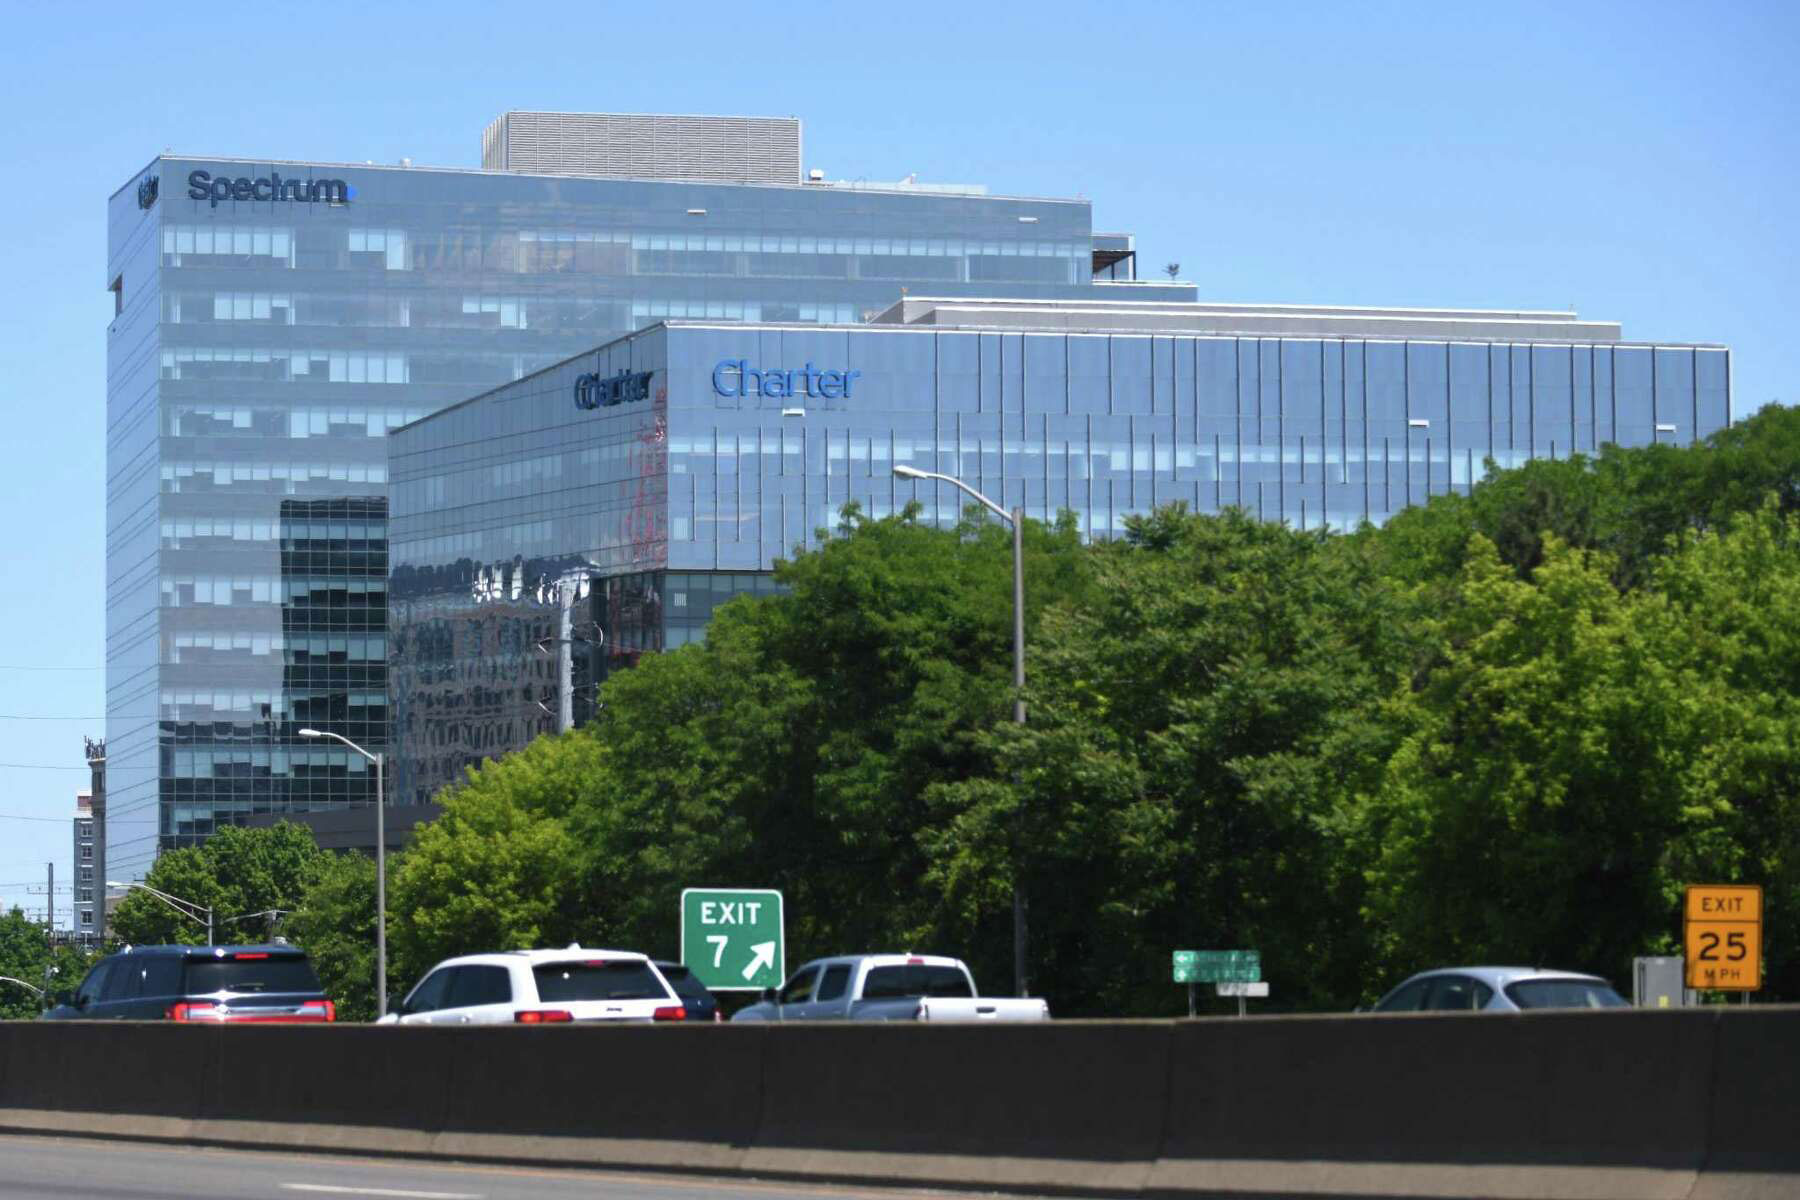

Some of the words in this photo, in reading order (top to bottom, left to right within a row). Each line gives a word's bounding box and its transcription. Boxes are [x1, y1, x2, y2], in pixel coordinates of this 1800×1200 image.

[188, 170, 348, 208] Spectrum
[713, 359, 862, 398] Charter
[701, 902, 761, 924] EXIT
[1701, 897, 1744, 912] EXIT
[705, 935, 729, 968] 7
[1699, 931, 1747, 961] 25
[1703, 968, 1741, 980] MPH
